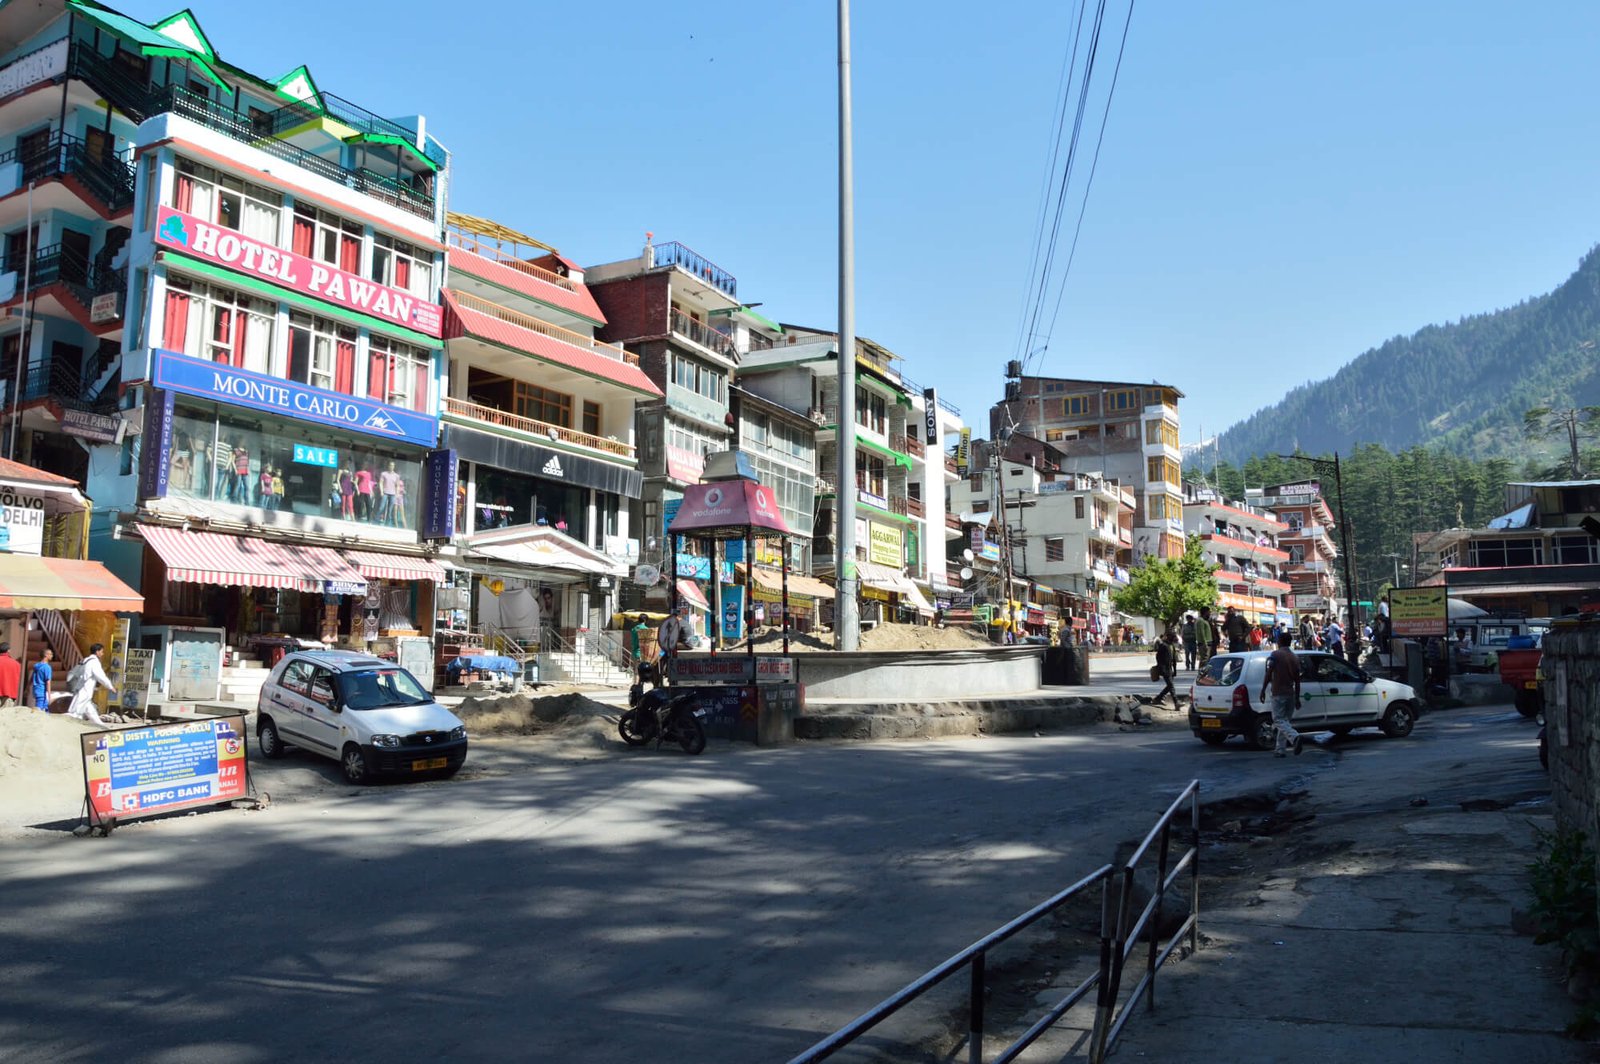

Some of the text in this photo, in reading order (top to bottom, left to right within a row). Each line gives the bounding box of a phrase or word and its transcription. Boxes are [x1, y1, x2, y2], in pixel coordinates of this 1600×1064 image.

[192, 223, 298, 284] HOTEL
[308, 264, 412, 322] PAWAN
[213, 372, 359, 422] MONTE CARLO
[64, 410, 89, 425] HOTEL
[90, 415, 119, 431] PAWAN
[926, 397, 936, 437] SONY
[160, 409, 172, 485] MONTE CARLO
[296, 446, 336, 464] SALE
[960, 433, 969, 459] Nikon
[542, 466, 563, 477] adidas
[0, 494, 44, 509] OLVO
[432, 465, 442, 533] MONTE CARLO
[3, 508, 43, 527] DELHI
[692, 507, 732, 517] vodafone
[133, 650, 153, 658] TAXI
[125, 730, 153, 742] DISTT.
[93, 754, 106, 763] NO
[142, 790, 175, 804] HDFC
[177, 784, 209, 798] BANK
